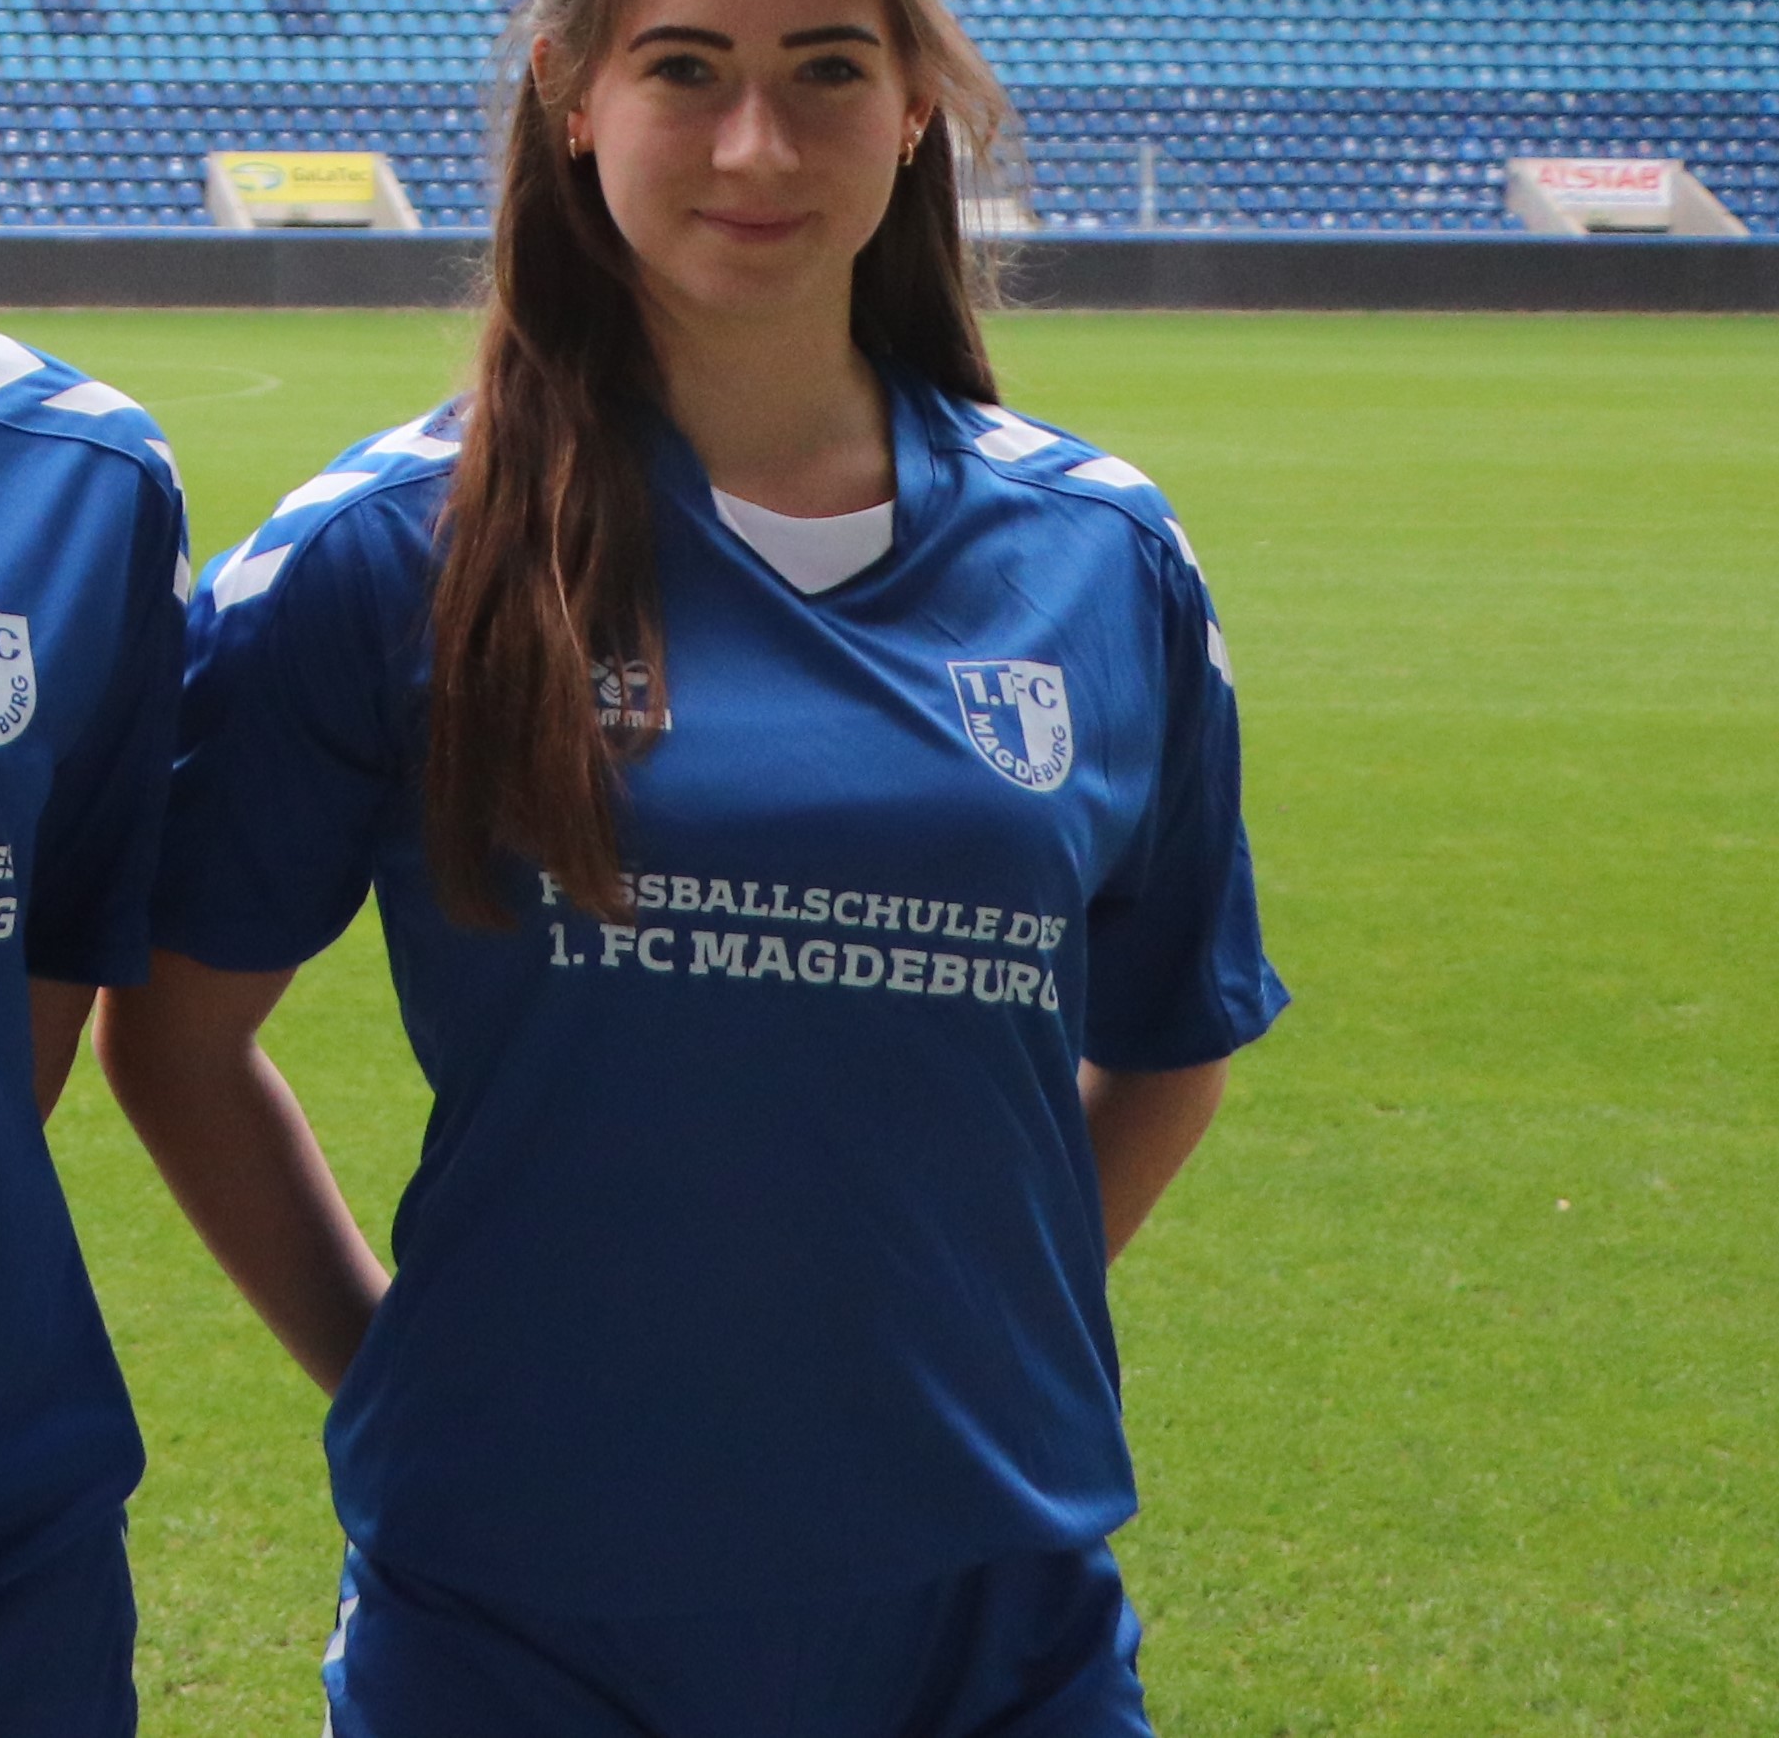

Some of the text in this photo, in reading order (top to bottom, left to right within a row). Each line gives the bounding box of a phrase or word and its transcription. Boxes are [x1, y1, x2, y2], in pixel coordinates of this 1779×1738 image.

[970, 712, 1068, 785] MAGDEBURG
[548, 922, 585, 967] 1.
[599, 922, 676, 973] FC
